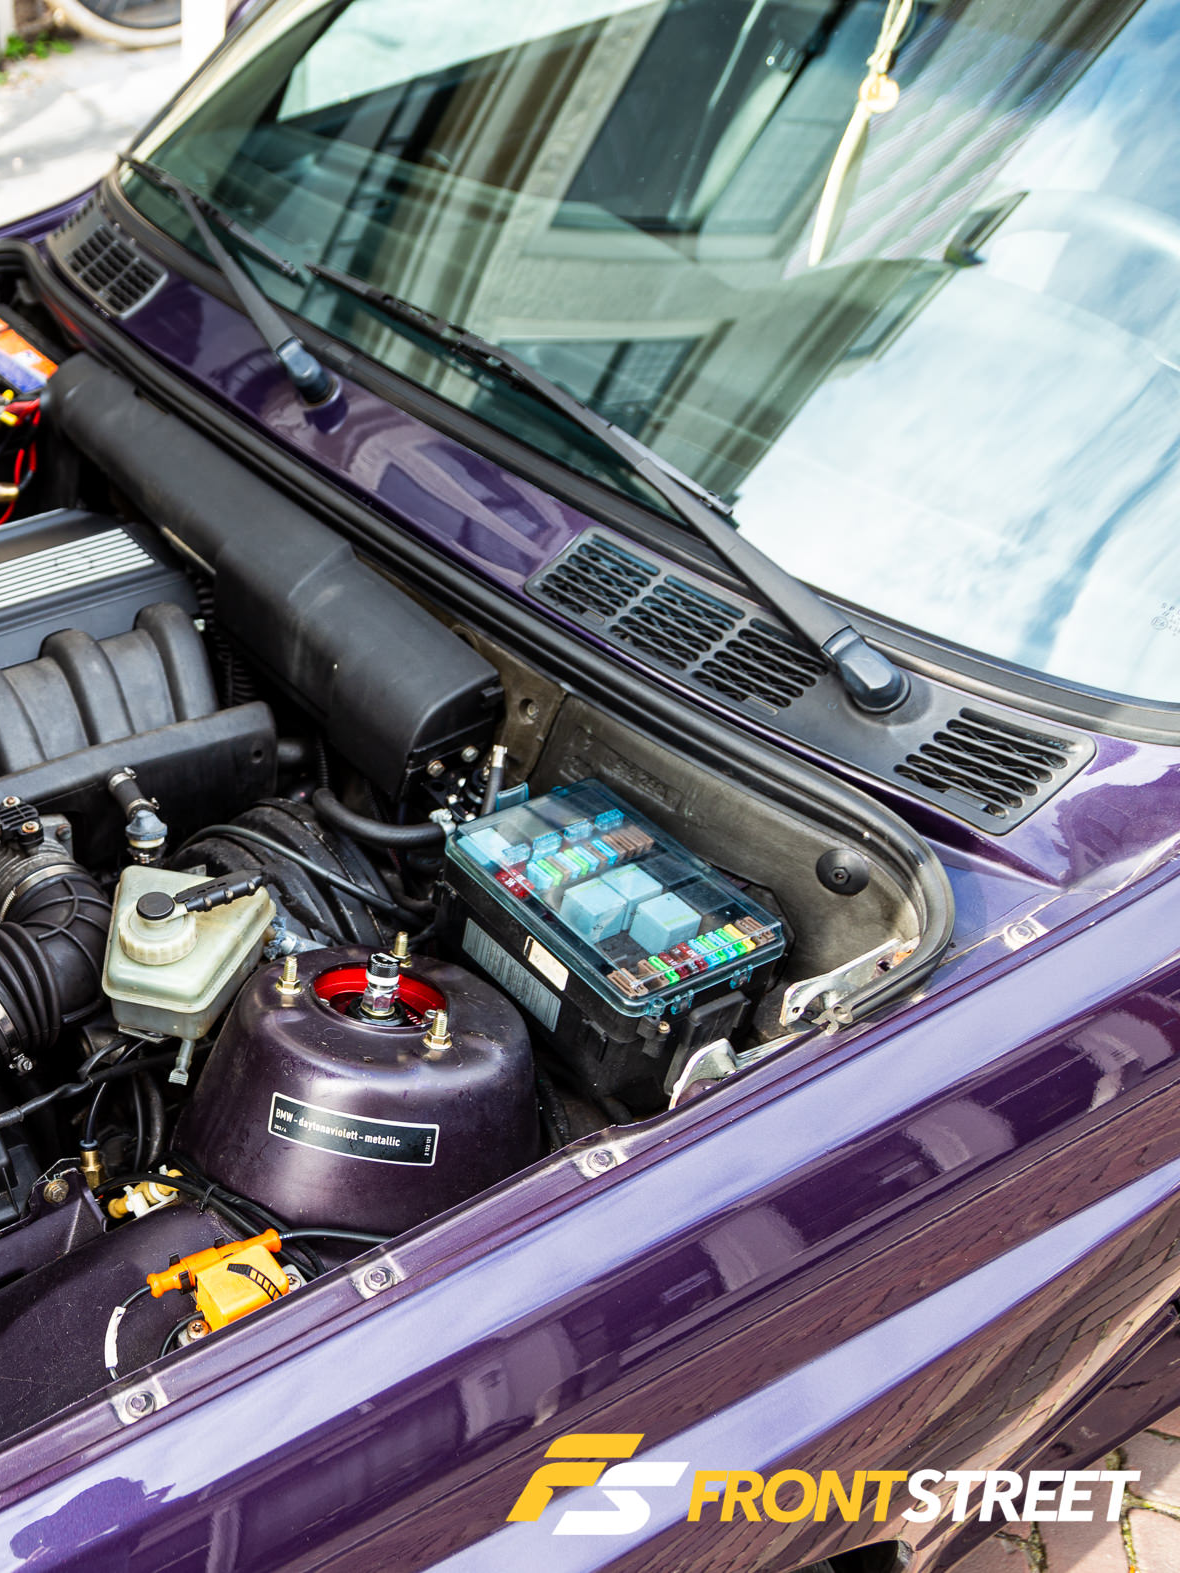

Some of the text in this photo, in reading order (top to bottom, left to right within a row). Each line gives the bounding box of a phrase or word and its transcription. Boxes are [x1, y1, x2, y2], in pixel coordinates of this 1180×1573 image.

[275, 1108, 294, 1123] BMW
[298, 1117, 359, 1141] daytonaviolett
[364, 1134, 401, 1147] metallic
